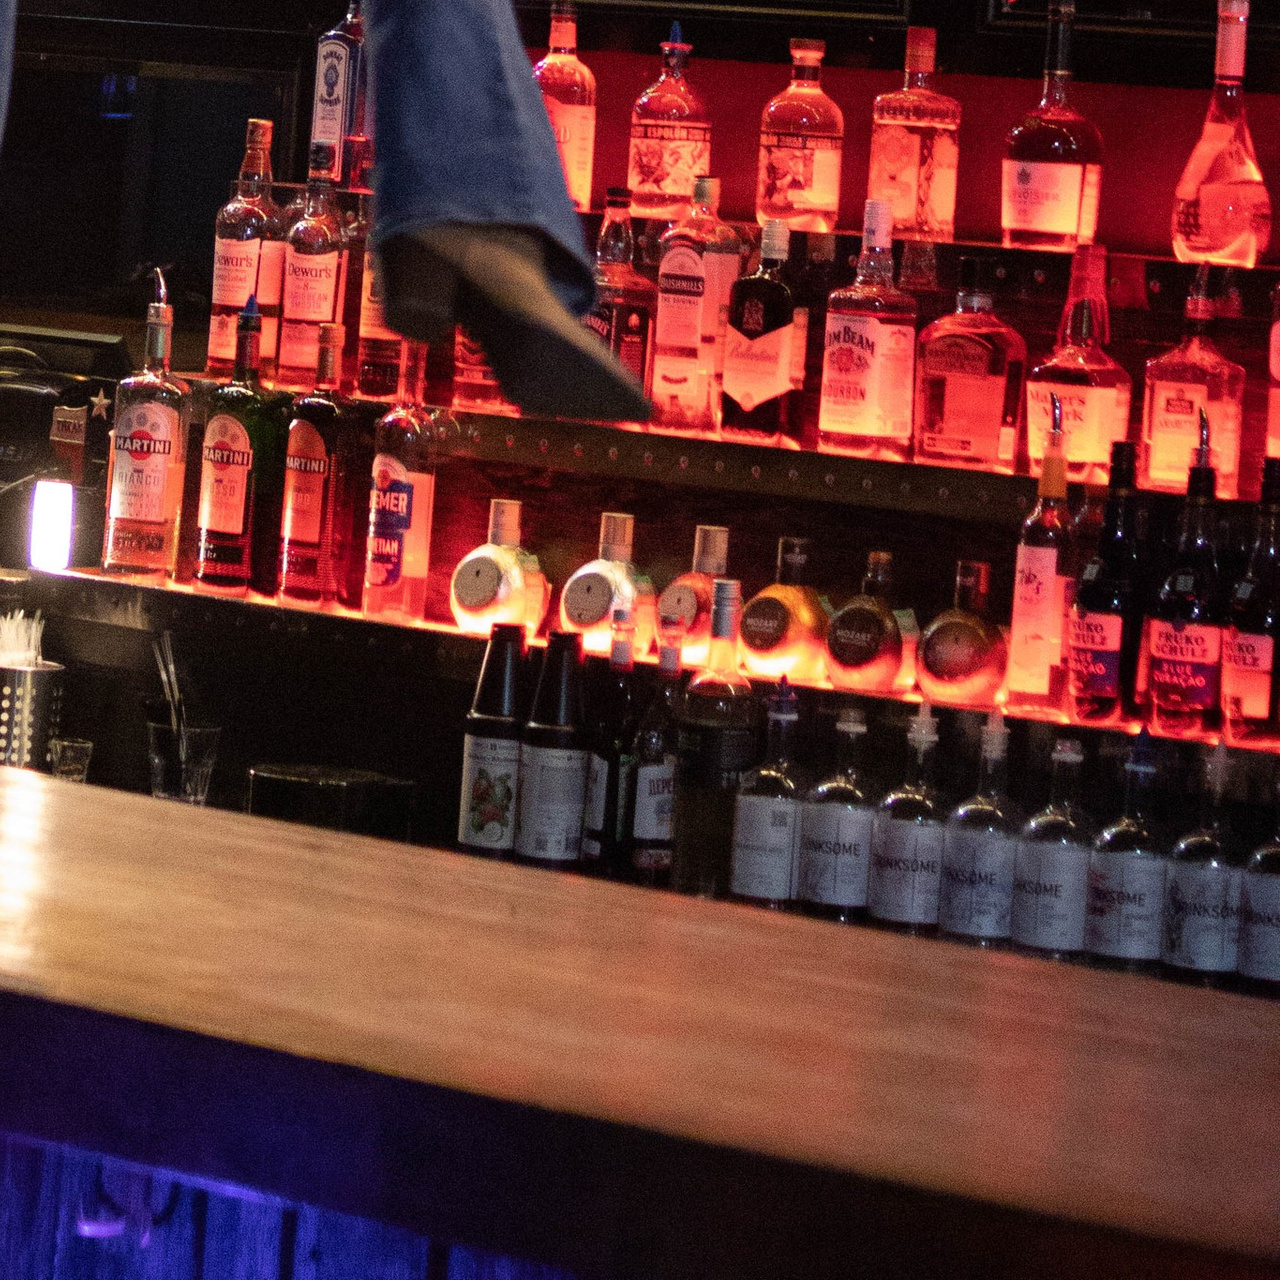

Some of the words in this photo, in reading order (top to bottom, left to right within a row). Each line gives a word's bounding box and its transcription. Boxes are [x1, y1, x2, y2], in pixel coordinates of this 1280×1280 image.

[843, 325, 876, 356] BEAM
[116, 437, 170, 454] MARTINI
[204, 447, 250, 466] MARTINI
[286, 456, 326, 474] MARTINI
